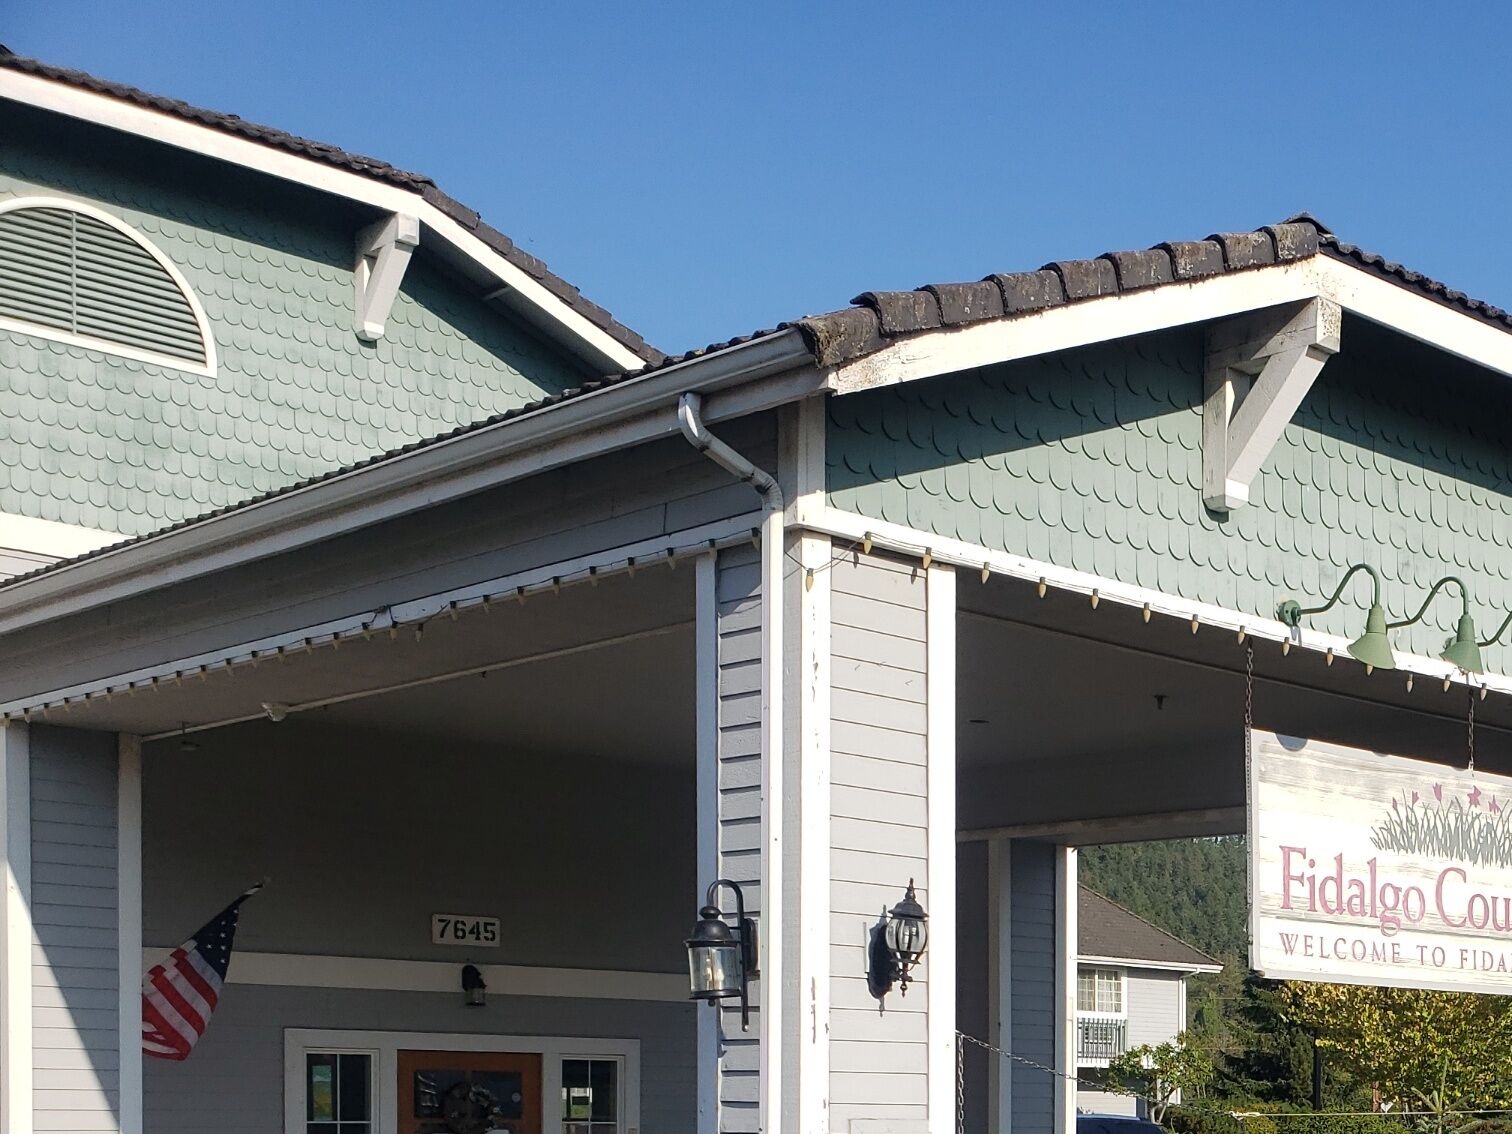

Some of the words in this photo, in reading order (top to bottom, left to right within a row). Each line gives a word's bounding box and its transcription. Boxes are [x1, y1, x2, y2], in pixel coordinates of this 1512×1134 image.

[1279, 845, 1426, 937] Fidalgo
[437, 919, 496, 941] 7645
[1279, 932, 1401, 964] WELCOME
[1416, 944, 1446, 967] TO
